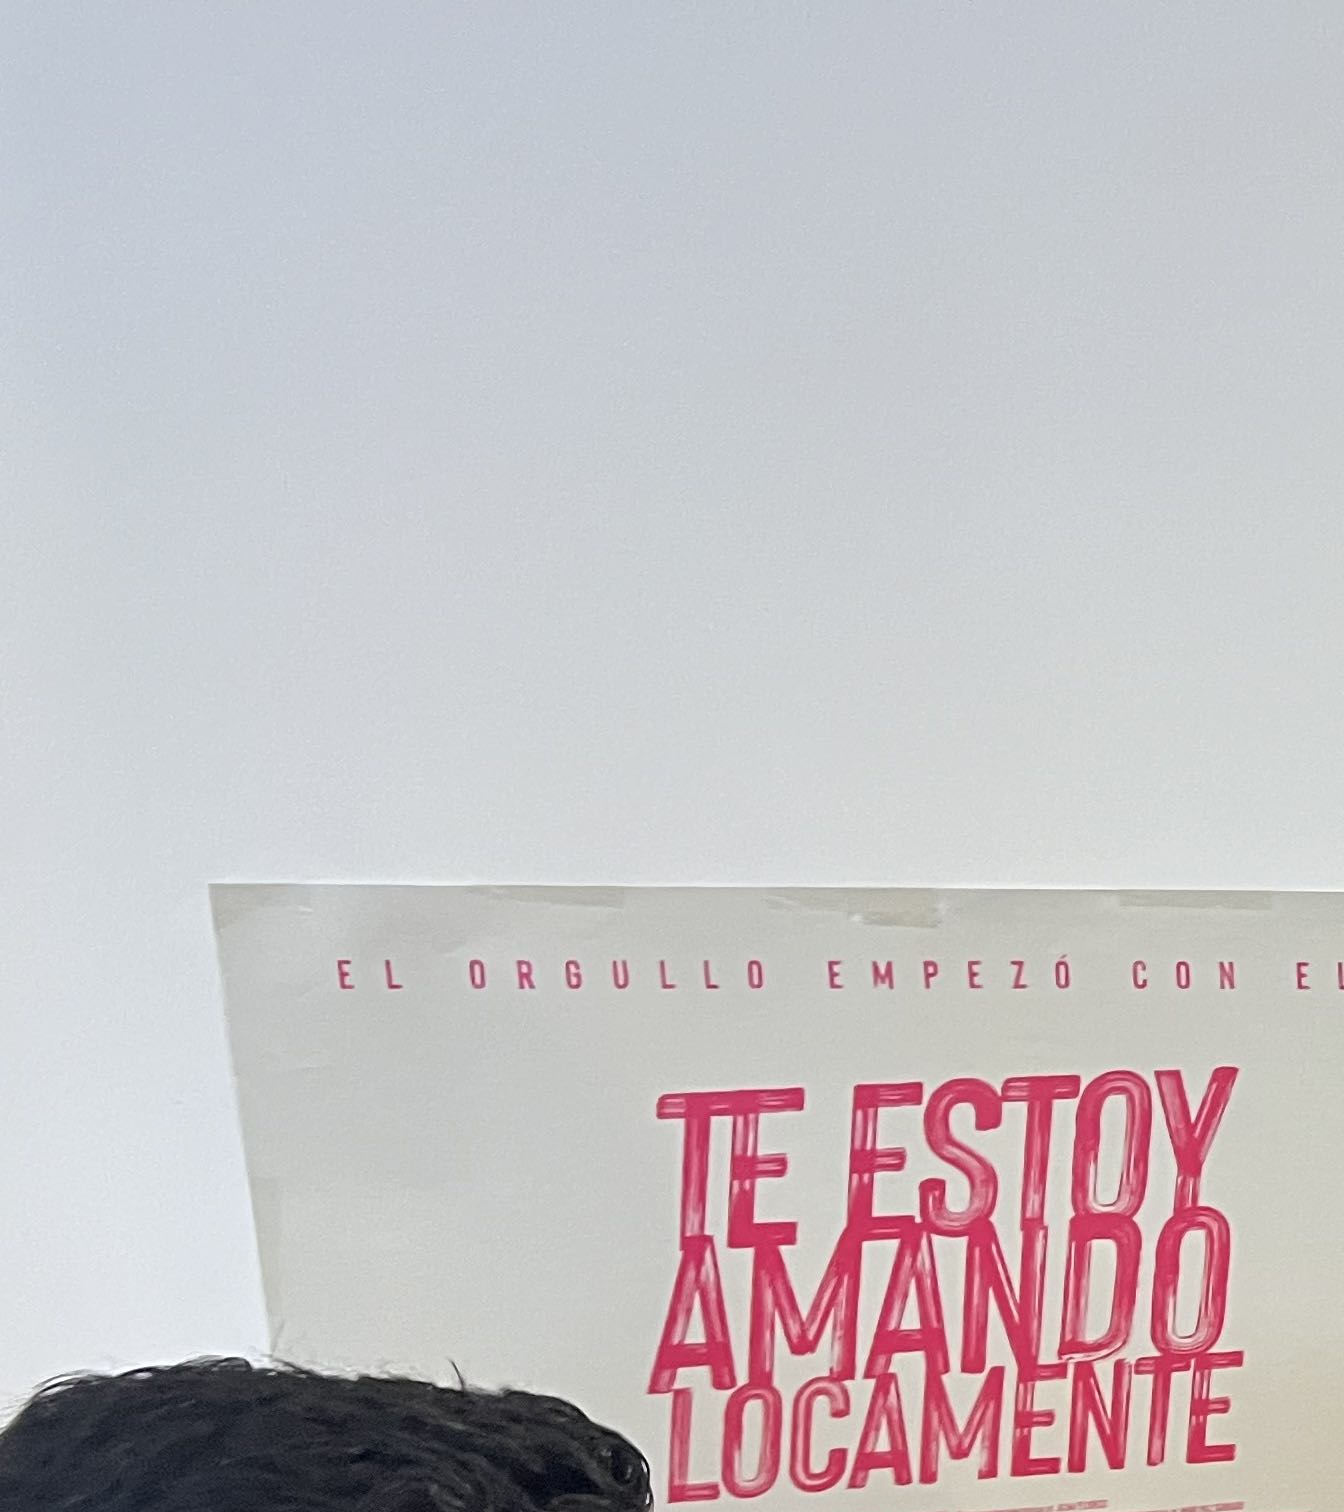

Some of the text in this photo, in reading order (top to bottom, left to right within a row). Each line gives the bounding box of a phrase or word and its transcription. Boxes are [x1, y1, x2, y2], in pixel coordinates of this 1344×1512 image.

[337, 960, 402, 989] EL
[469, 959, 765, 990] ORGULLO
[827, 953, 1073, 990] EMPEZÓ
[1132, 960, 1237, 990] CON
[656, 1066, 1239, 1250] TE ESTOY
[648, 1206, 1231, 1393] AMANDO
[667, 1350, 1243, 1503] LOCAMENTE
